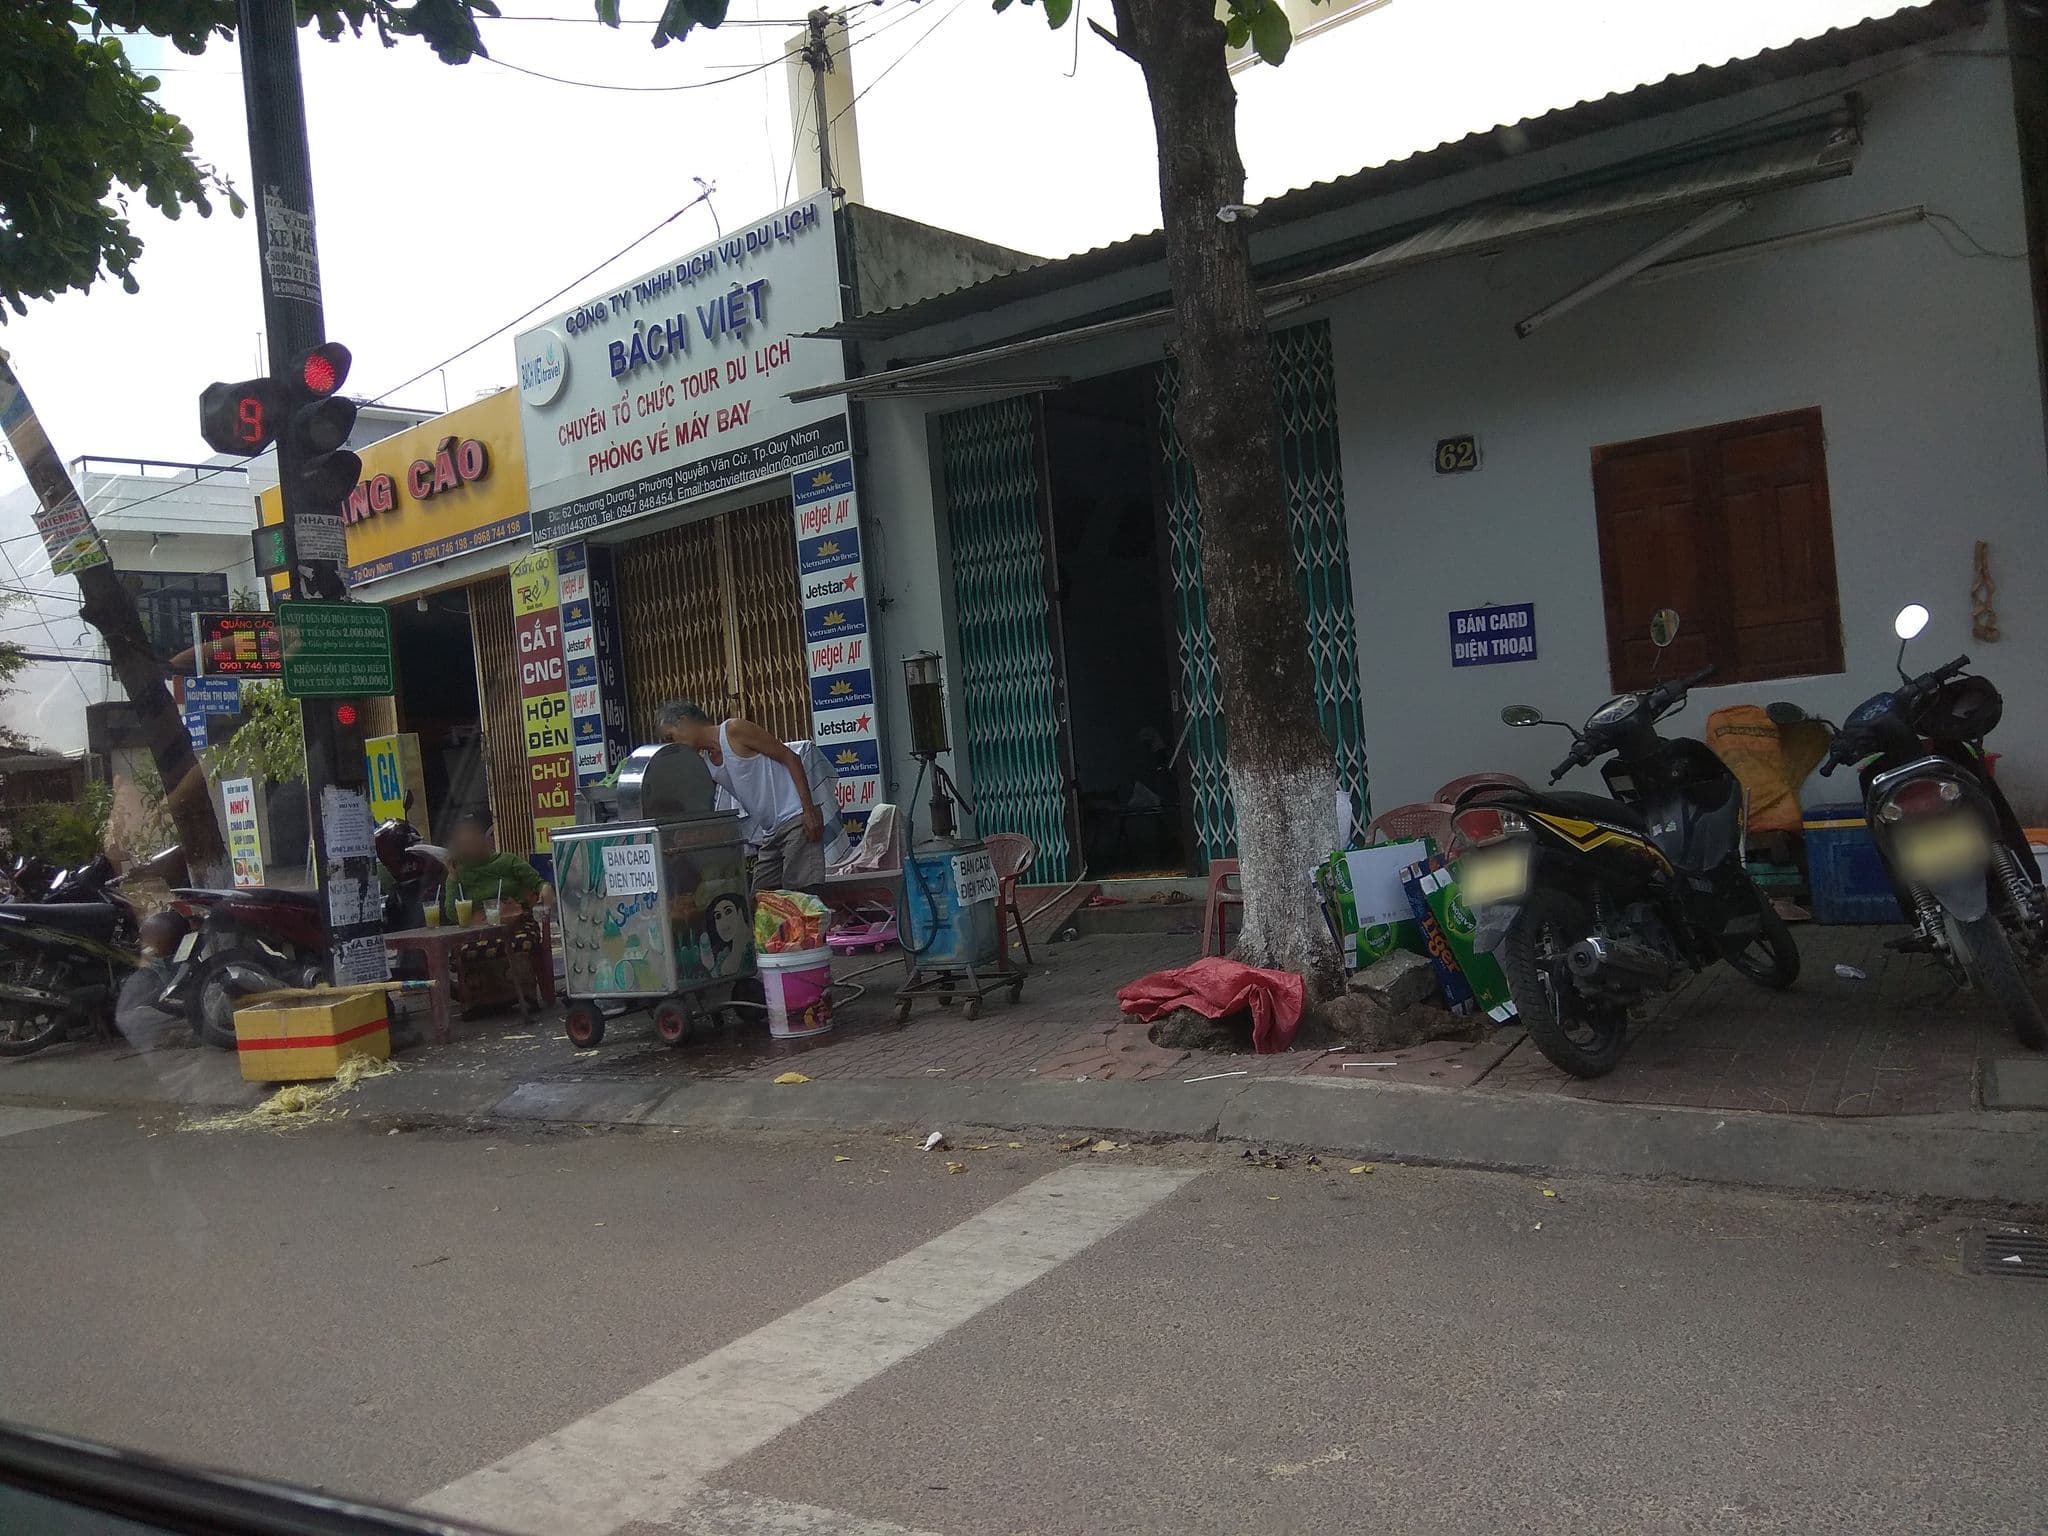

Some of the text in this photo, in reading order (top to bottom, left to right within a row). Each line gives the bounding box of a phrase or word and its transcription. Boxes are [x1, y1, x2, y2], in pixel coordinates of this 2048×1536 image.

[566, 203, 816, 334] CÔNG TY TNHH DỊCH VỤ DU LỊCH
[609, 279, 768, 378] BÁCH VIỆT
[542, 360, 560, 382] travel
[559, 339, 791, 447] CHUYÊN TỔ CHỨC TOUR DU LỊCH
[240, 398, 263, 442] 9
[589, 400, 751, 476] PHÒNG VÉ MÁY BAY
[408, 437, 484, 500] CÁO
[1439, 441, 1475, 471] 62
[562, 507, 572, 519] 62
[574, 498, 604, 515] Chương
[639, 475, 673, 495] Phường
[711, 457, 730, 473] Văn
[791, 429, 820, 448] Nhơn
[796, 480, 852, 500] Vietnam Airlines
[601, 509, 615, 523] Tel:
[616, 502, 636, 518] 0947
[835, 499, 850, 525] Air
[507, 520, 521, 535] 198
[802, 551, 858, 570] Vietnam Airlines
[805, 580, 844, 600] Jetstar
[808, 621, 865, 638] Vietnam Airlines
[1457, 611, 1528, 634] BÁN CARD
[520, 618, 558, 653] CẮT
[1455, 635, 1533, 661] ĐIỆN THOẠI
[848, 639, 862, 665] Air
[220, 662, 281, 670] 0901 746 198
[523, 657, 563, 685] CNC
[526, 696, 566, 724] HỘP
[814, 691, 871, 707] Vietnam Airlines
[528, 724, 569, 749] ĐÈN
[818, 720, 857, 737] Jetstar
[377, 742, 401, 801] GÀ
[531, 756, 571, 781] CHỮ
[850, 762, 878, 771] Airlines
[537, 782, 570, 809] NỔI
[861, 780, 875, 804] Air
[627, 849, 651, 866] CARD
